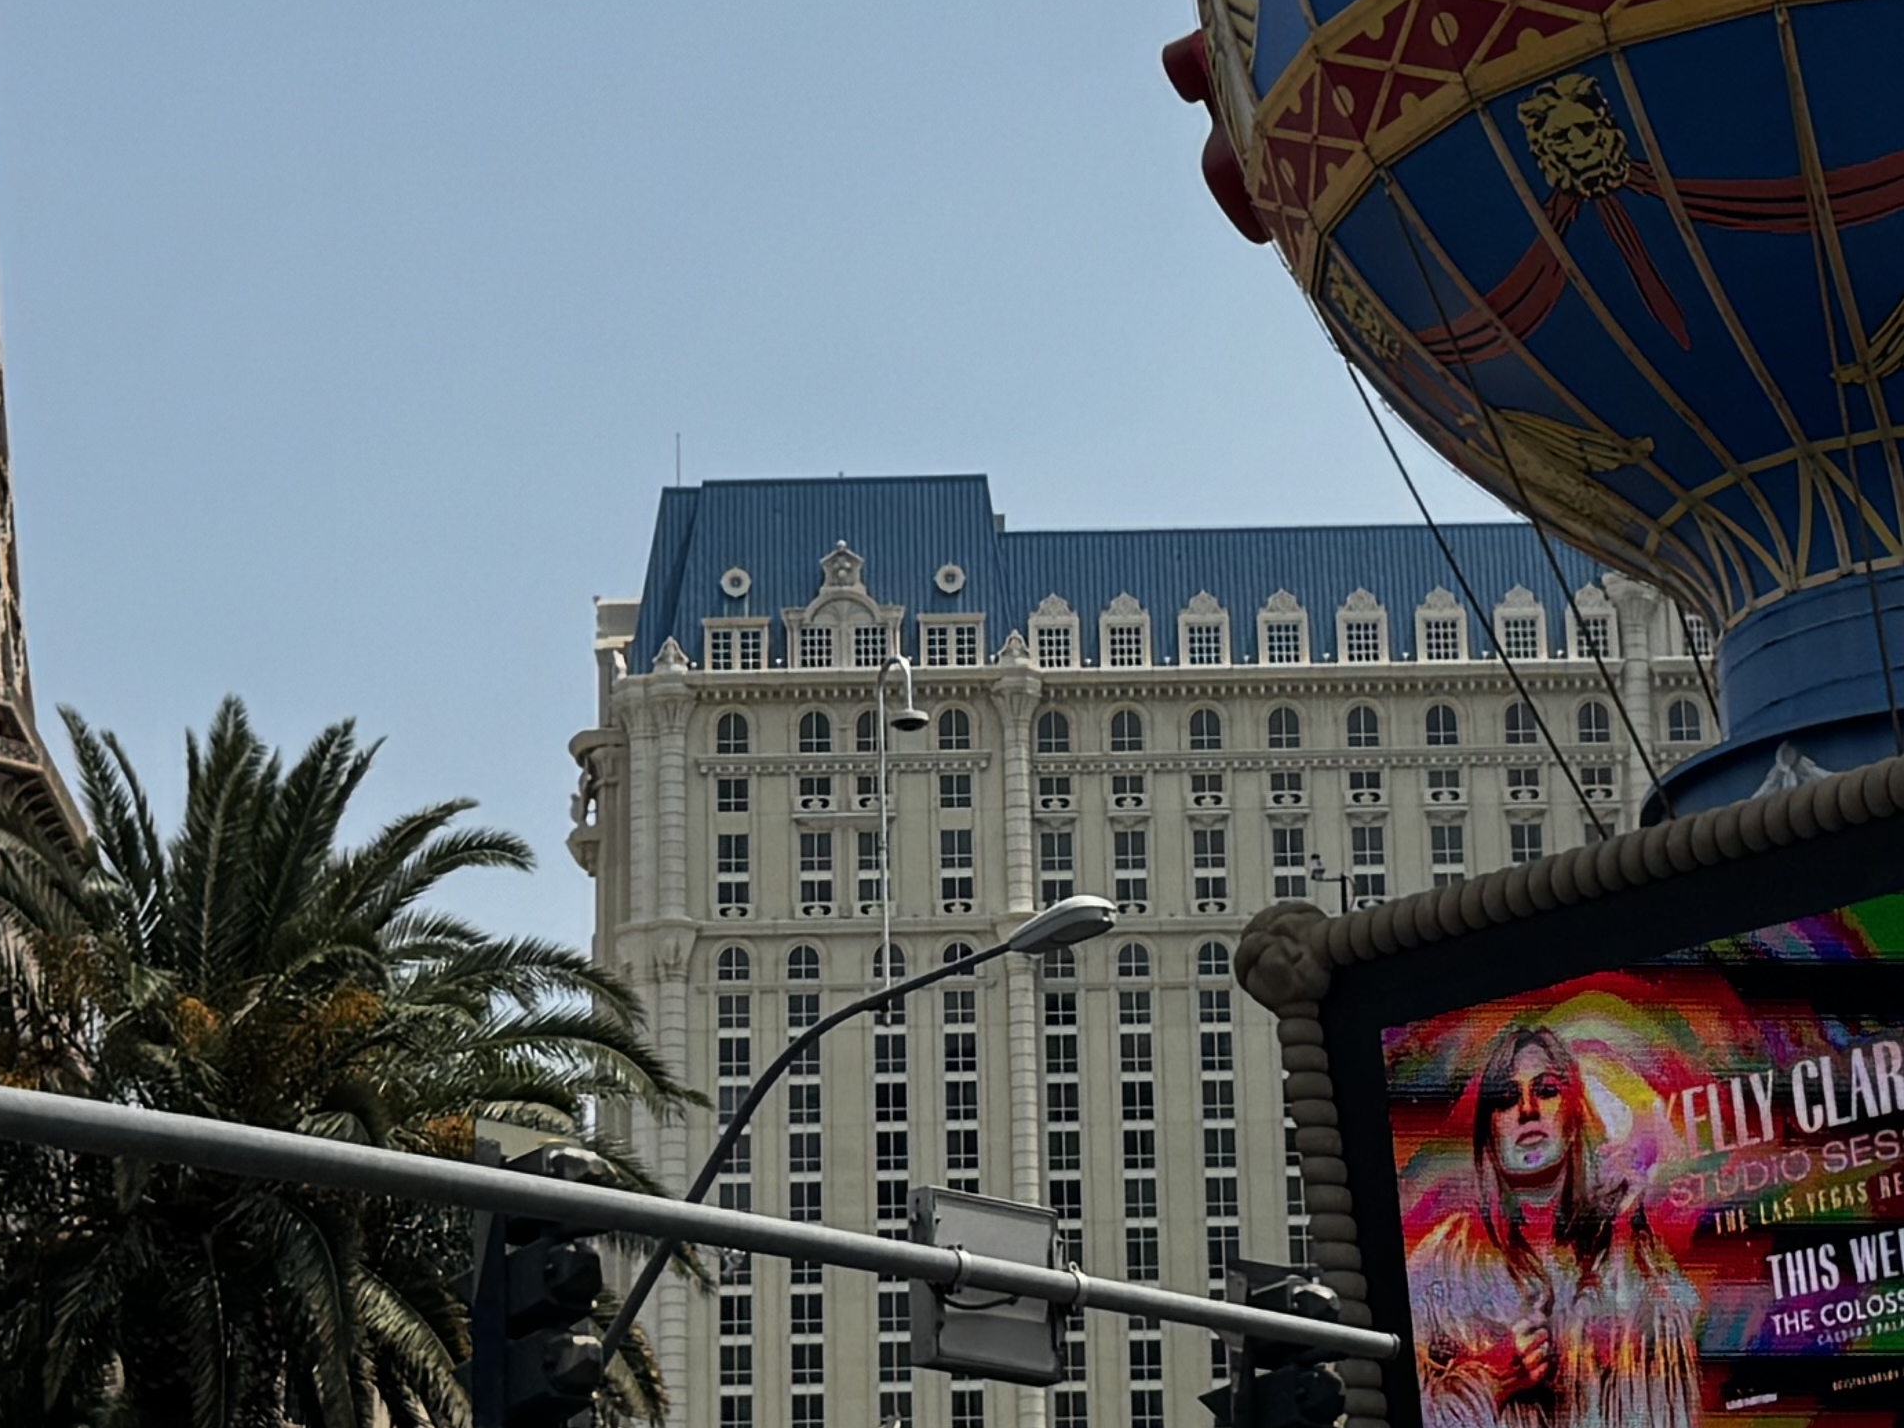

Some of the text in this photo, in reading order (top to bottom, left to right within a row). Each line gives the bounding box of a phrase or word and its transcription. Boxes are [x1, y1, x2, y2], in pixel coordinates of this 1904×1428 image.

[1669, 1149, 1812, 1208] STUDIO
[1715, 1208, 1749, 1235] THE
[1760, 1197, 1796, 1226] LAS
[1806, 1180, 1869, 1218] VEGAS
[1766, 1243, 1840, 1300] THIS
[1770, 1310, 1815, 1336] THE
